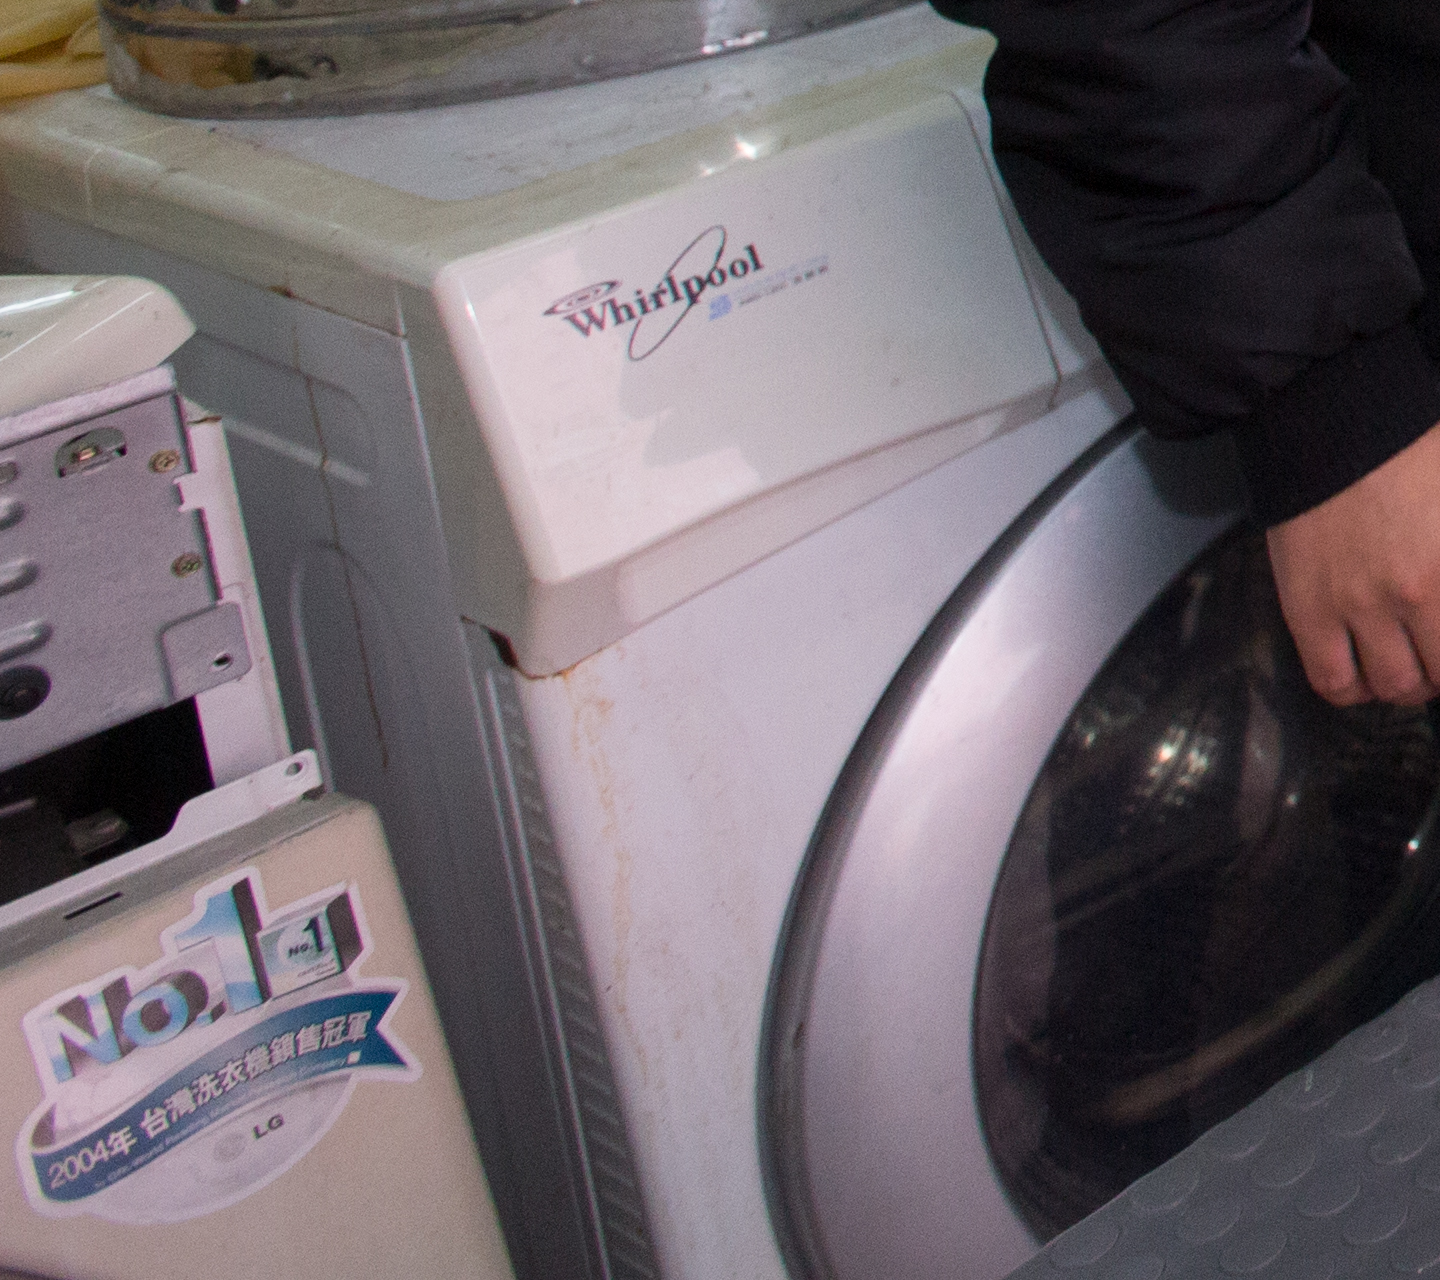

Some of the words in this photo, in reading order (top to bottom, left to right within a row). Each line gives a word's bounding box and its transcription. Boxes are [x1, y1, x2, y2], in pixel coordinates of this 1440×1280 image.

[563, 243, 765, 338] Whirlpool
[40, 877, 270, 1083] No.1
[47, 1125, 138, 1190] 2004年
[251, 1112, 285, 1140] LG
